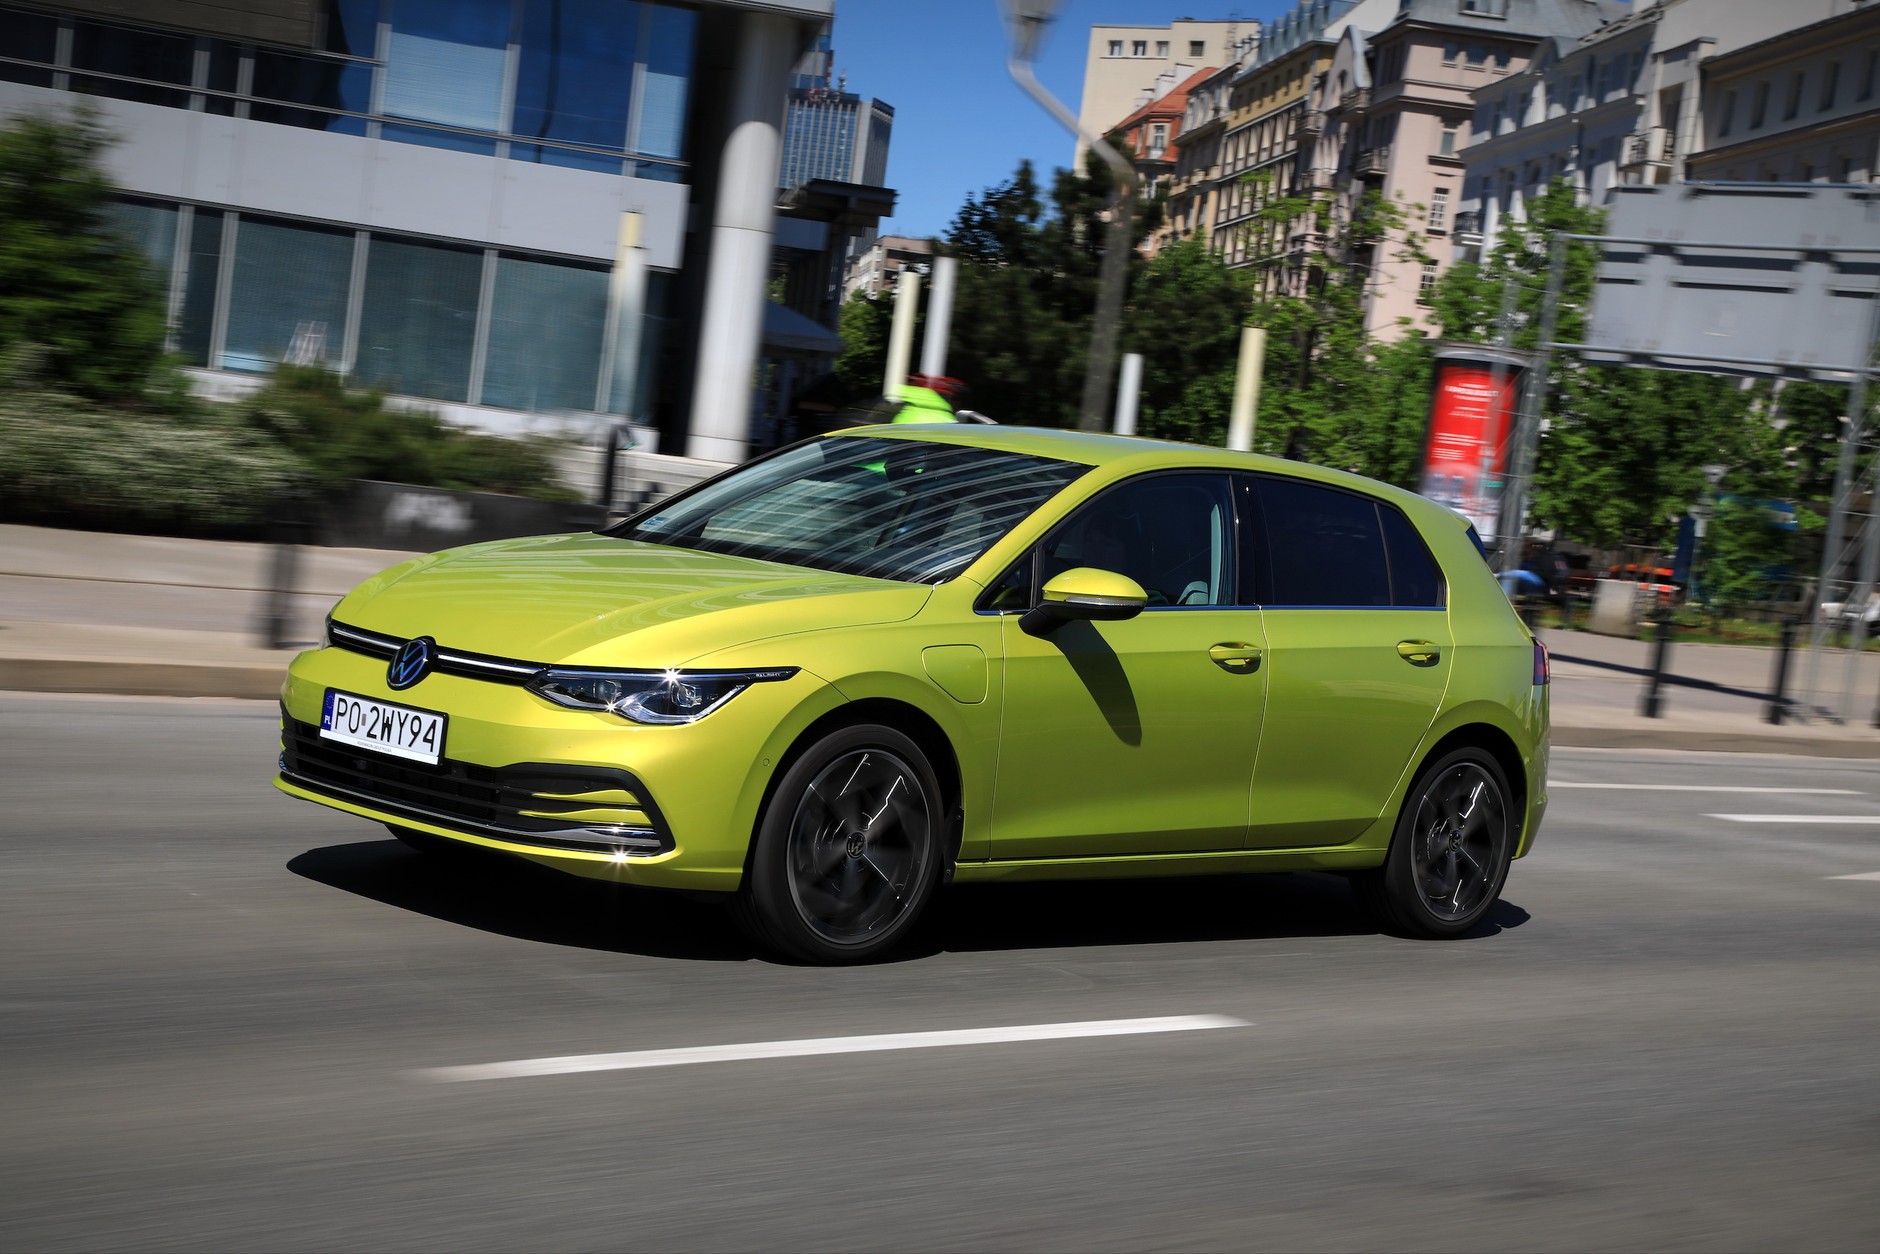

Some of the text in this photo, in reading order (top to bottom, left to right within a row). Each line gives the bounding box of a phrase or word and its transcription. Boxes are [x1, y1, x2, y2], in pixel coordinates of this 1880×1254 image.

[324, 715, 331, 725] PL
[335, 698, 437, 753] PO 2WY94
